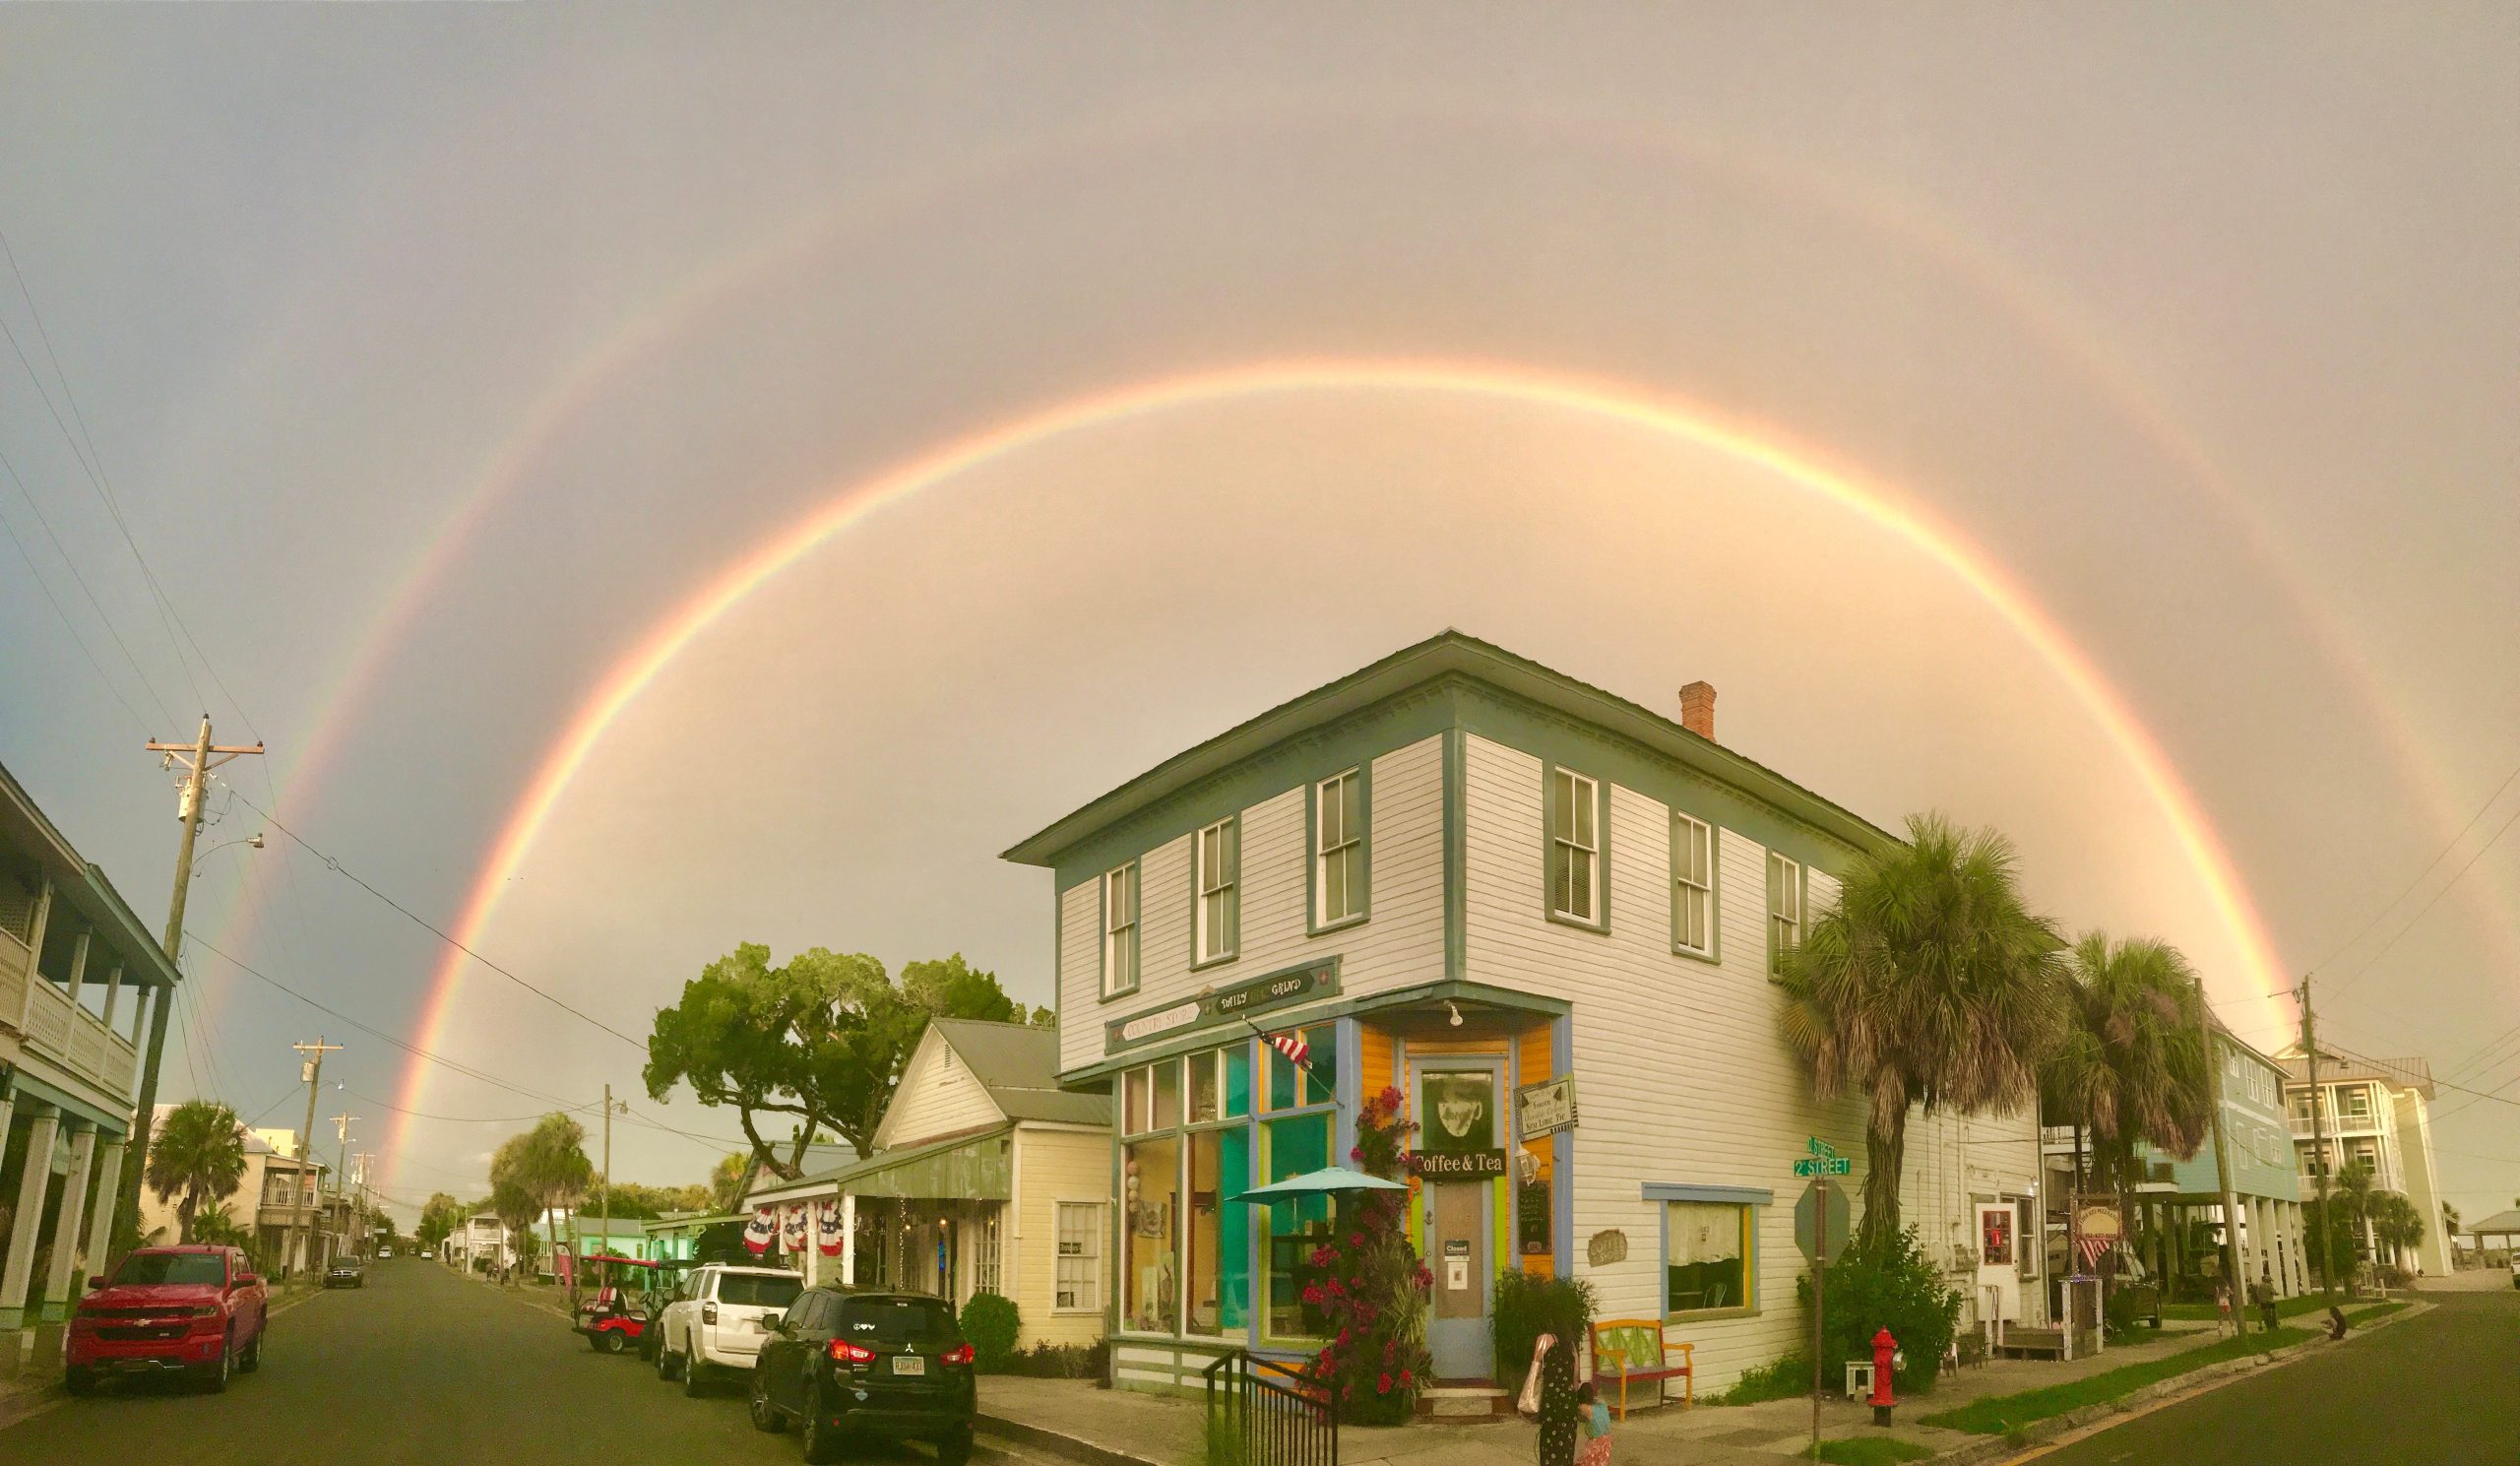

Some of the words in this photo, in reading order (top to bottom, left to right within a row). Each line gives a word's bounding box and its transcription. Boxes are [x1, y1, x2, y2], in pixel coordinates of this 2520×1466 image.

[1222, 991, 1247, 1009] DAILY
[1272, 979, 1301, 995] GRIND
[1813, 1138, 1835, 1159] STREET
[1417, 1155, 1460, 1173] Coffee
[1462, 1154, 1473, 1172] &
[1476, 1154, 1502, 1172] Tea
[1808, 1158, 1849, 1176] STREET
